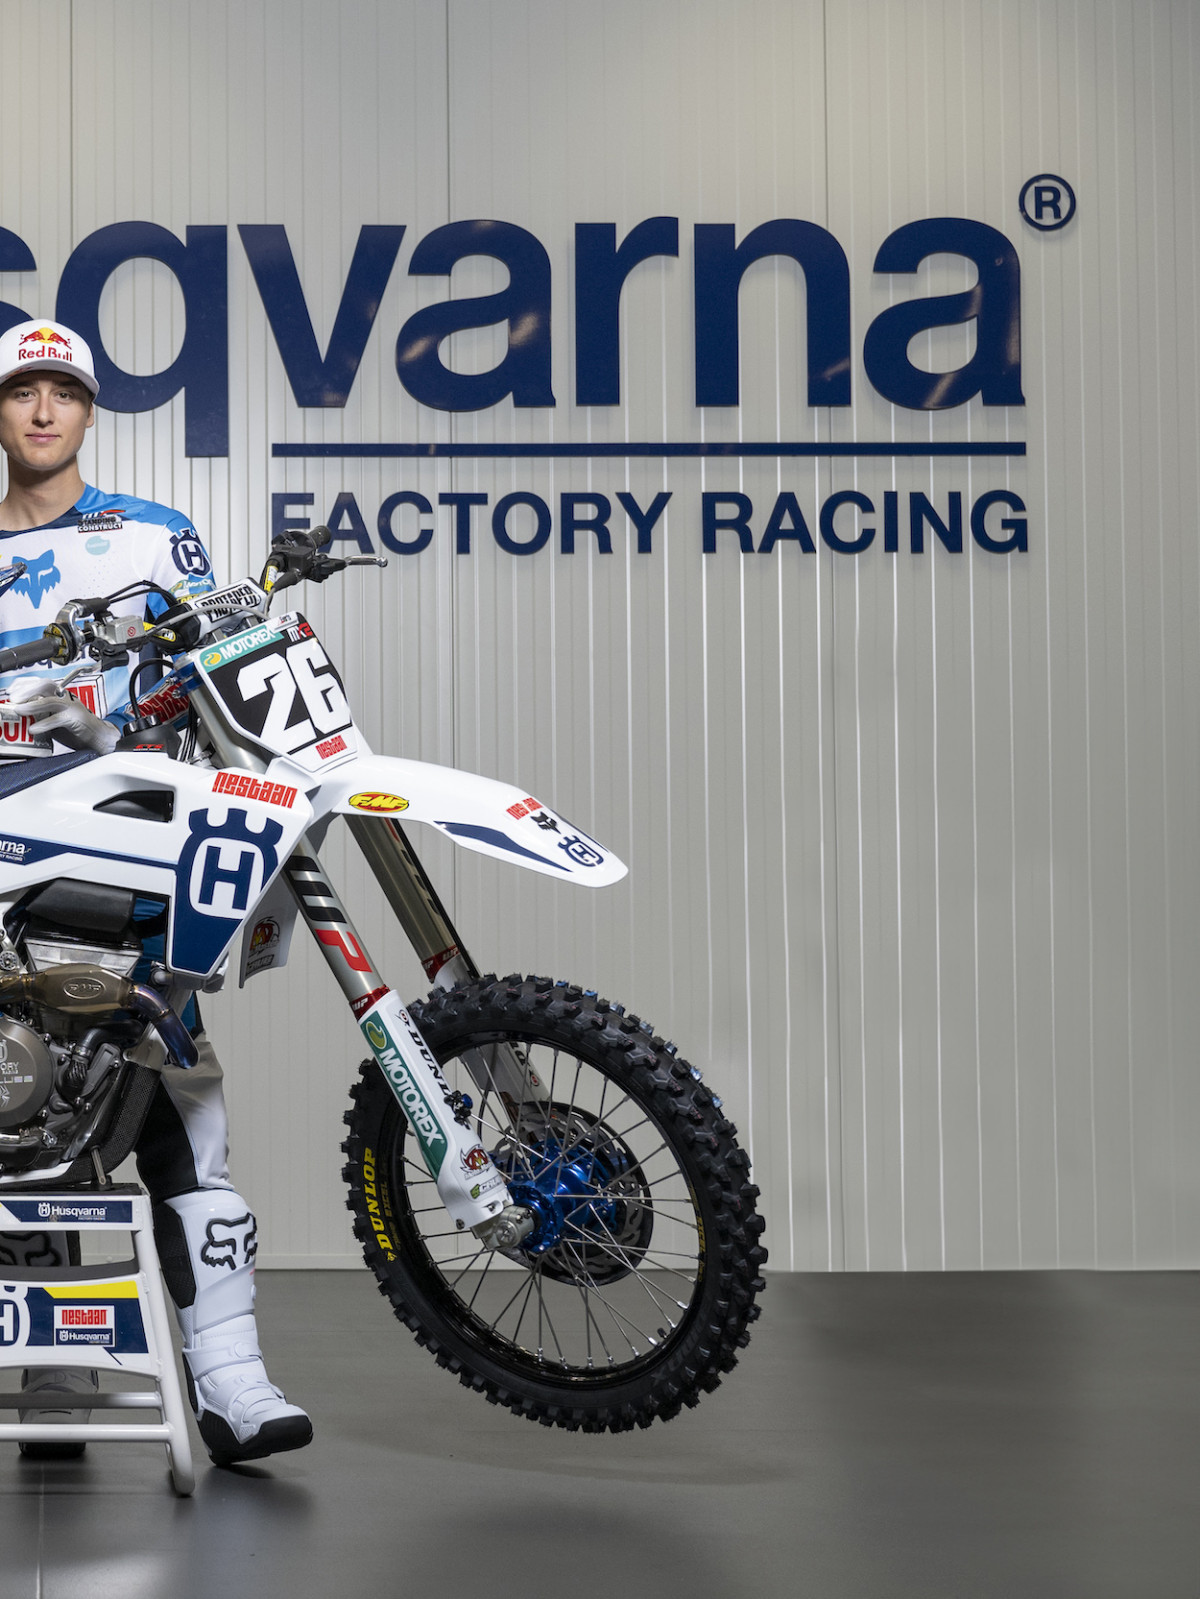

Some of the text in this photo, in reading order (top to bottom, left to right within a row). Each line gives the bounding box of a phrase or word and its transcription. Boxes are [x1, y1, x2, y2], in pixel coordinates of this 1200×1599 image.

[19, 346, 72, 362] Red Bull
[78, 522, 122, 532] CONSTRUCT
[272, 489, 1029, 556] FACTORY RACING
[220, 626, 276, 661] MOTOREX
[237, 638, 353, 739] 26
[315, 735, 347, 760] nestaan
[211, 771, 299, 809] nestaan
[349, 793, 409, 810] FMF
[408, 1029, 453, 1096] DUNL
[379, 1048, 444, 1148] MOTOREX
[51, 1205, 106, 1217] Husqvarna
[363, 1147, 393, 1250] DUNLOP
[62, 1309, 107, 1325] nestaan
[69, 1332, 110, 1342] Husqvarna
